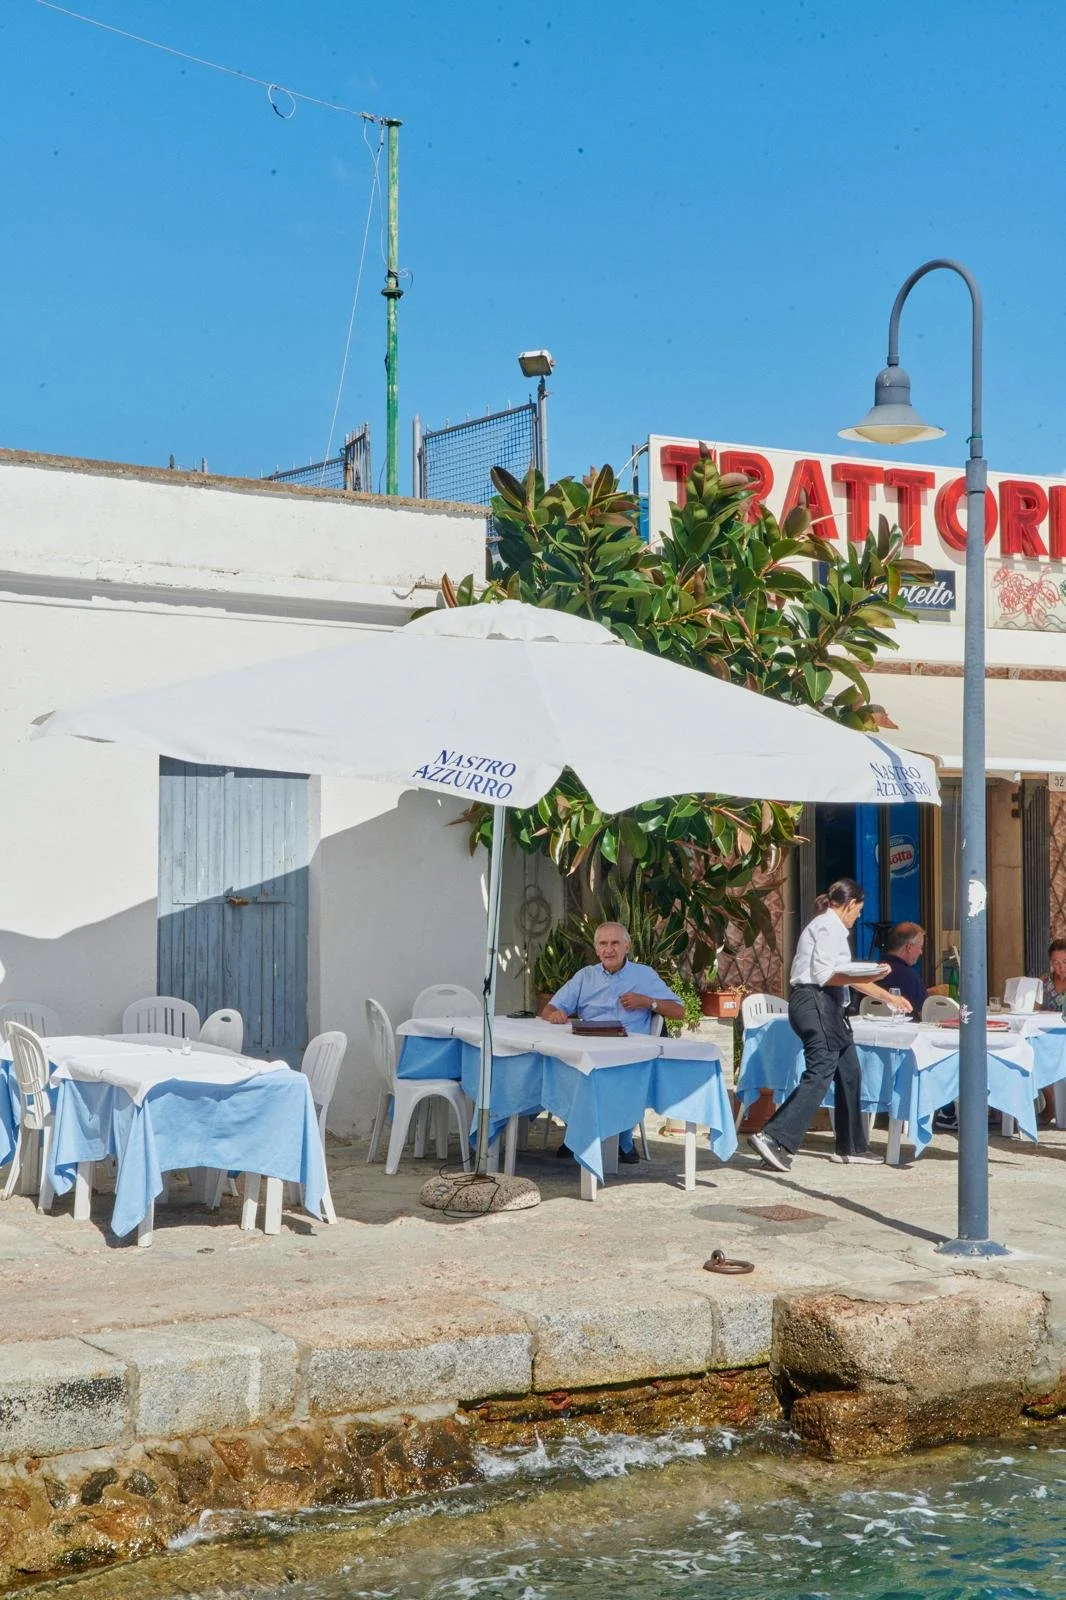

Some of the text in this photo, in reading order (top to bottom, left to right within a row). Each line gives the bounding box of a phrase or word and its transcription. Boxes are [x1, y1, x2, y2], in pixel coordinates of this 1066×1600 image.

[433, 749, 517, 778] NASTRO
[869, 762, 921, 780] NASTRO
[412, 764, 513, 799] AZZURRO
[876, 780, 931, 797] AZZURRO
[1054, 775, 1065, 787] 52
[888, 850, 913, 865] otta
